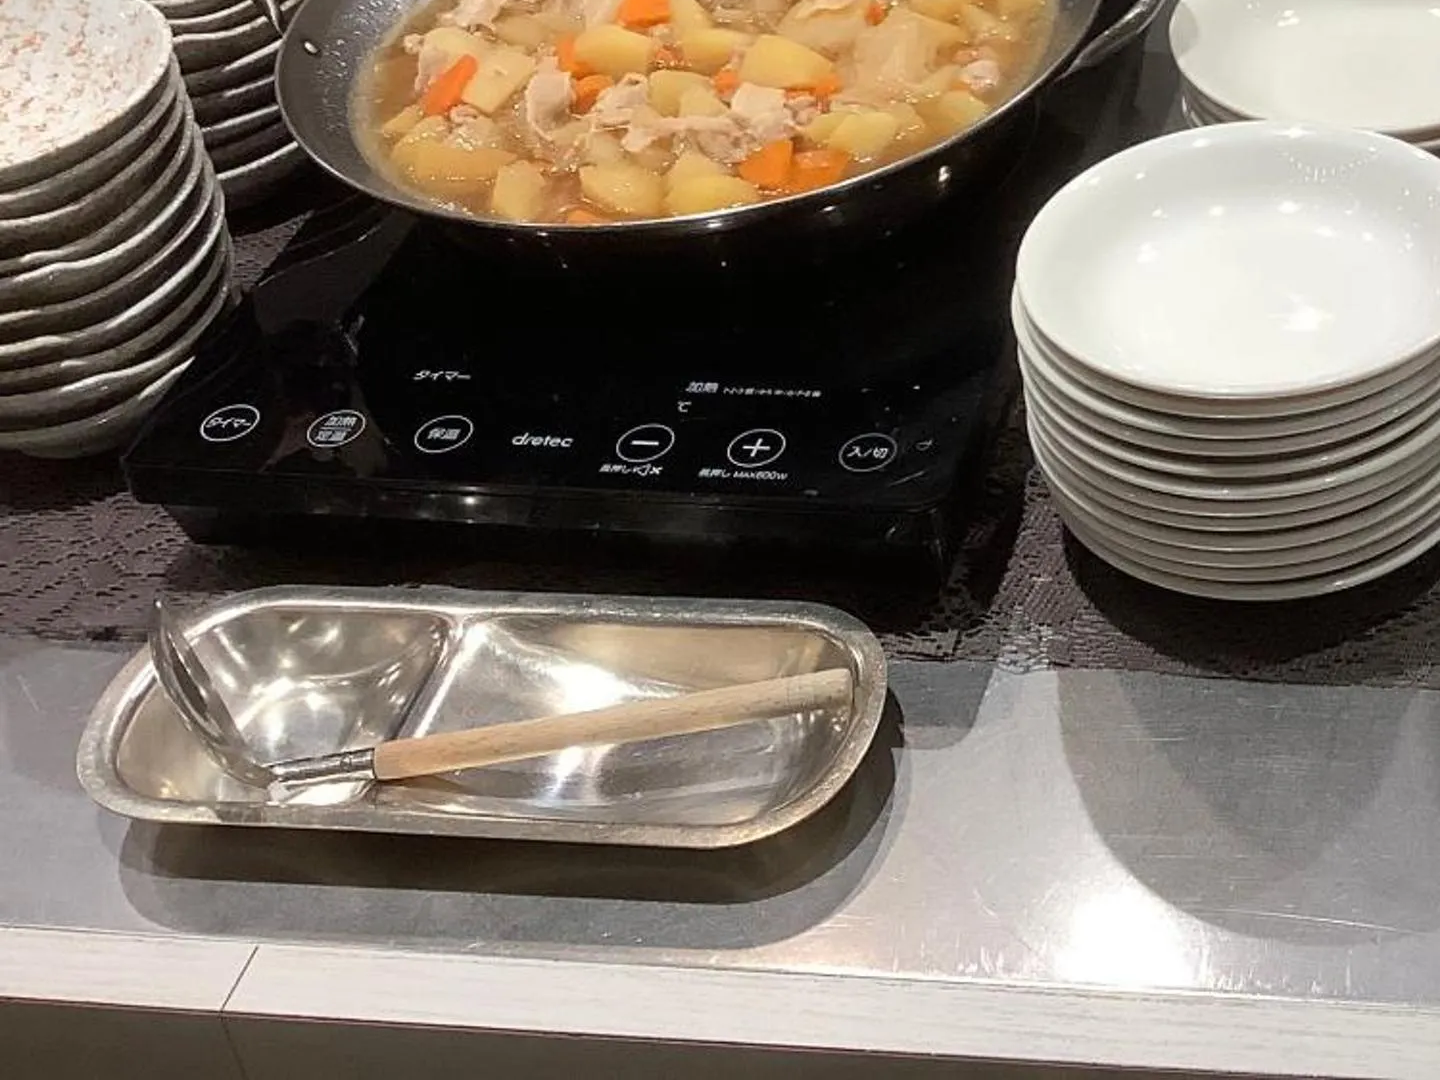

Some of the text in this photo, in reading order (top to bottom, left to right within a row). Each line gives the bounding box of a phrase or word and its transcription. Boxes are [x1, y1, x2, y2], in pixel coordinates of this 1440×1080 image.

[413, 370, 471, 381] タイマー
[205, 417, 251, 428] タイマー
[512, 432, 574, 448] dretec
